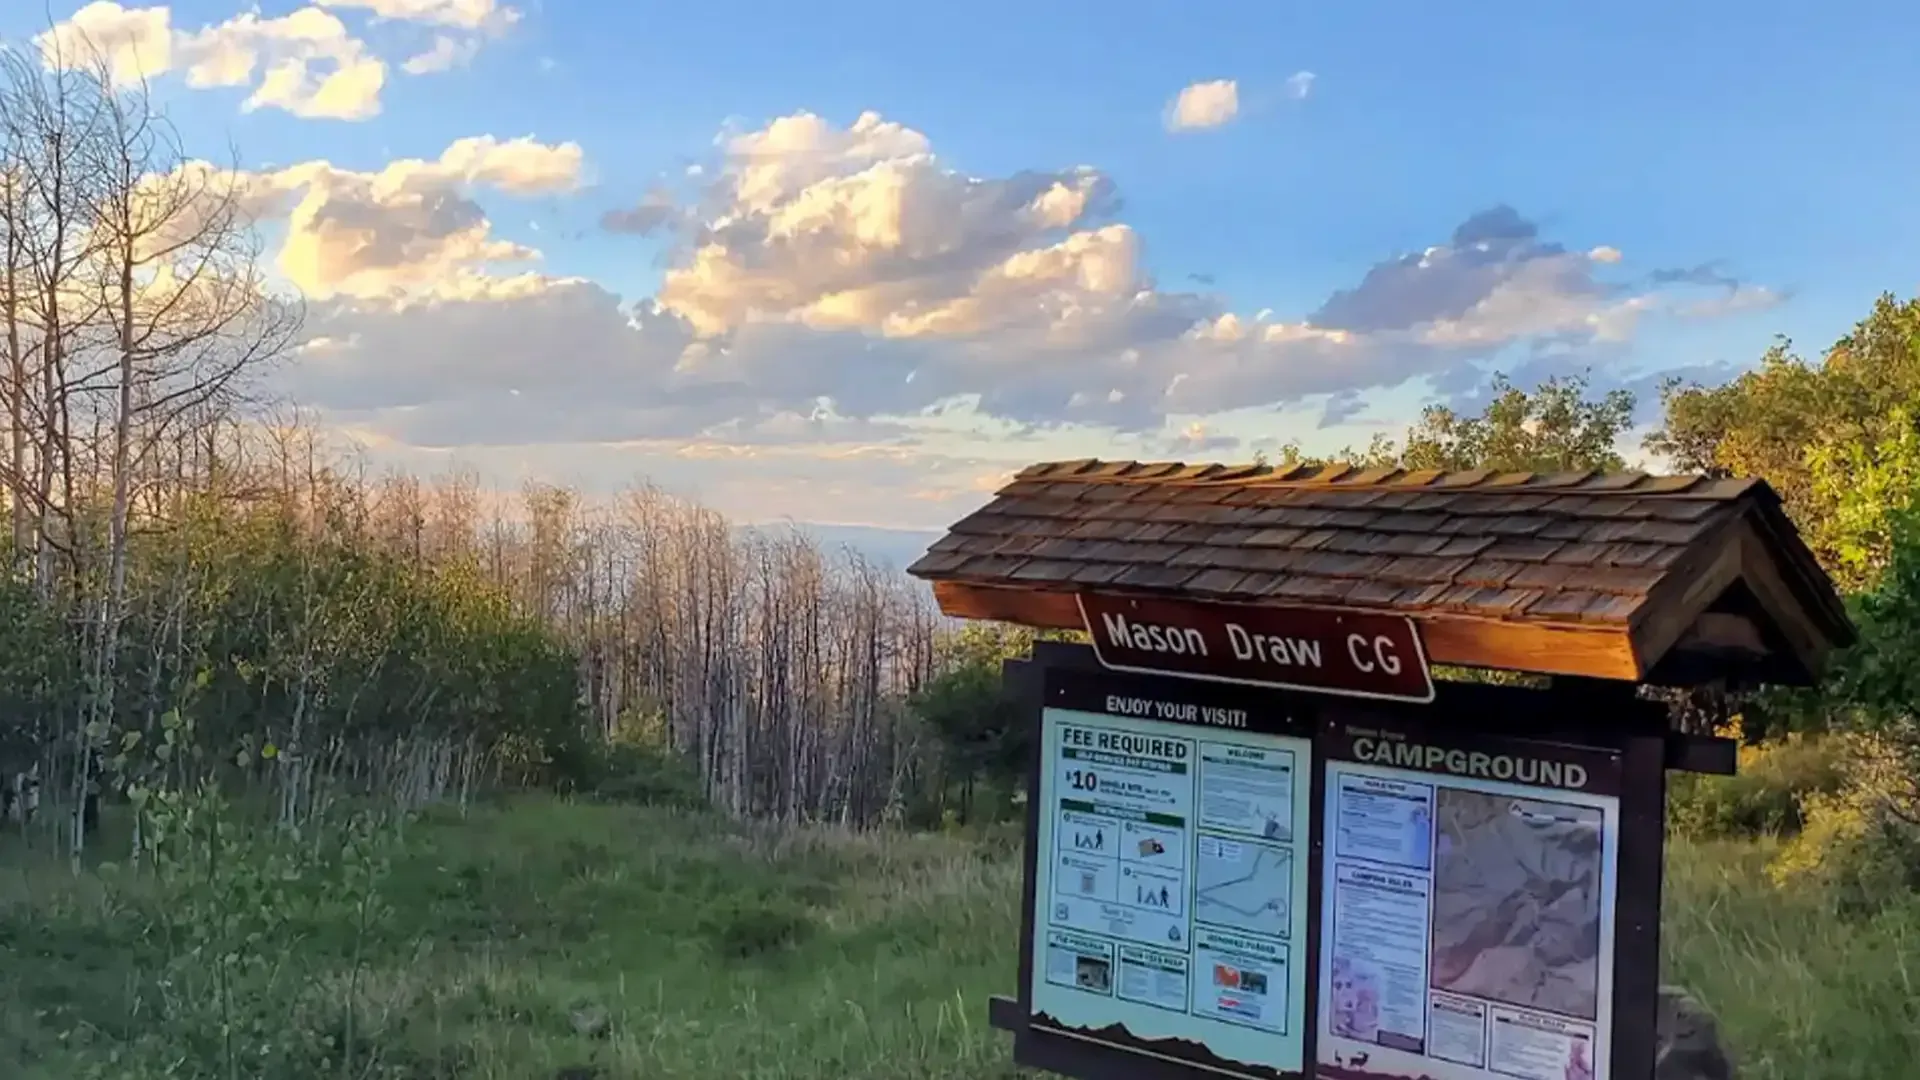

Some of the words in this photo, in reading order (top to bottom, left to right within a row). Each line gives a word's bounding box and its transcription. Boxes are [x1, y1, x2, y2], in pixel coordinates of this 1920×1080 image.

[1102, 612, 1208, 656] Mason
[1226, 623, 1322, 668] Draw
[1347, 633, 1401, 675] CG
[1106, 695, 1152, 715] ENJOY
[1155, 701, 1198, 721] YOUR
[1202, 706, 1247, 728] VISIT!
[1063, 728, 1093, 746] FEE
[1098, 732, 1187, 759] REQUIRED
[1352, 738, 1588, 788] CAMPGROUND
